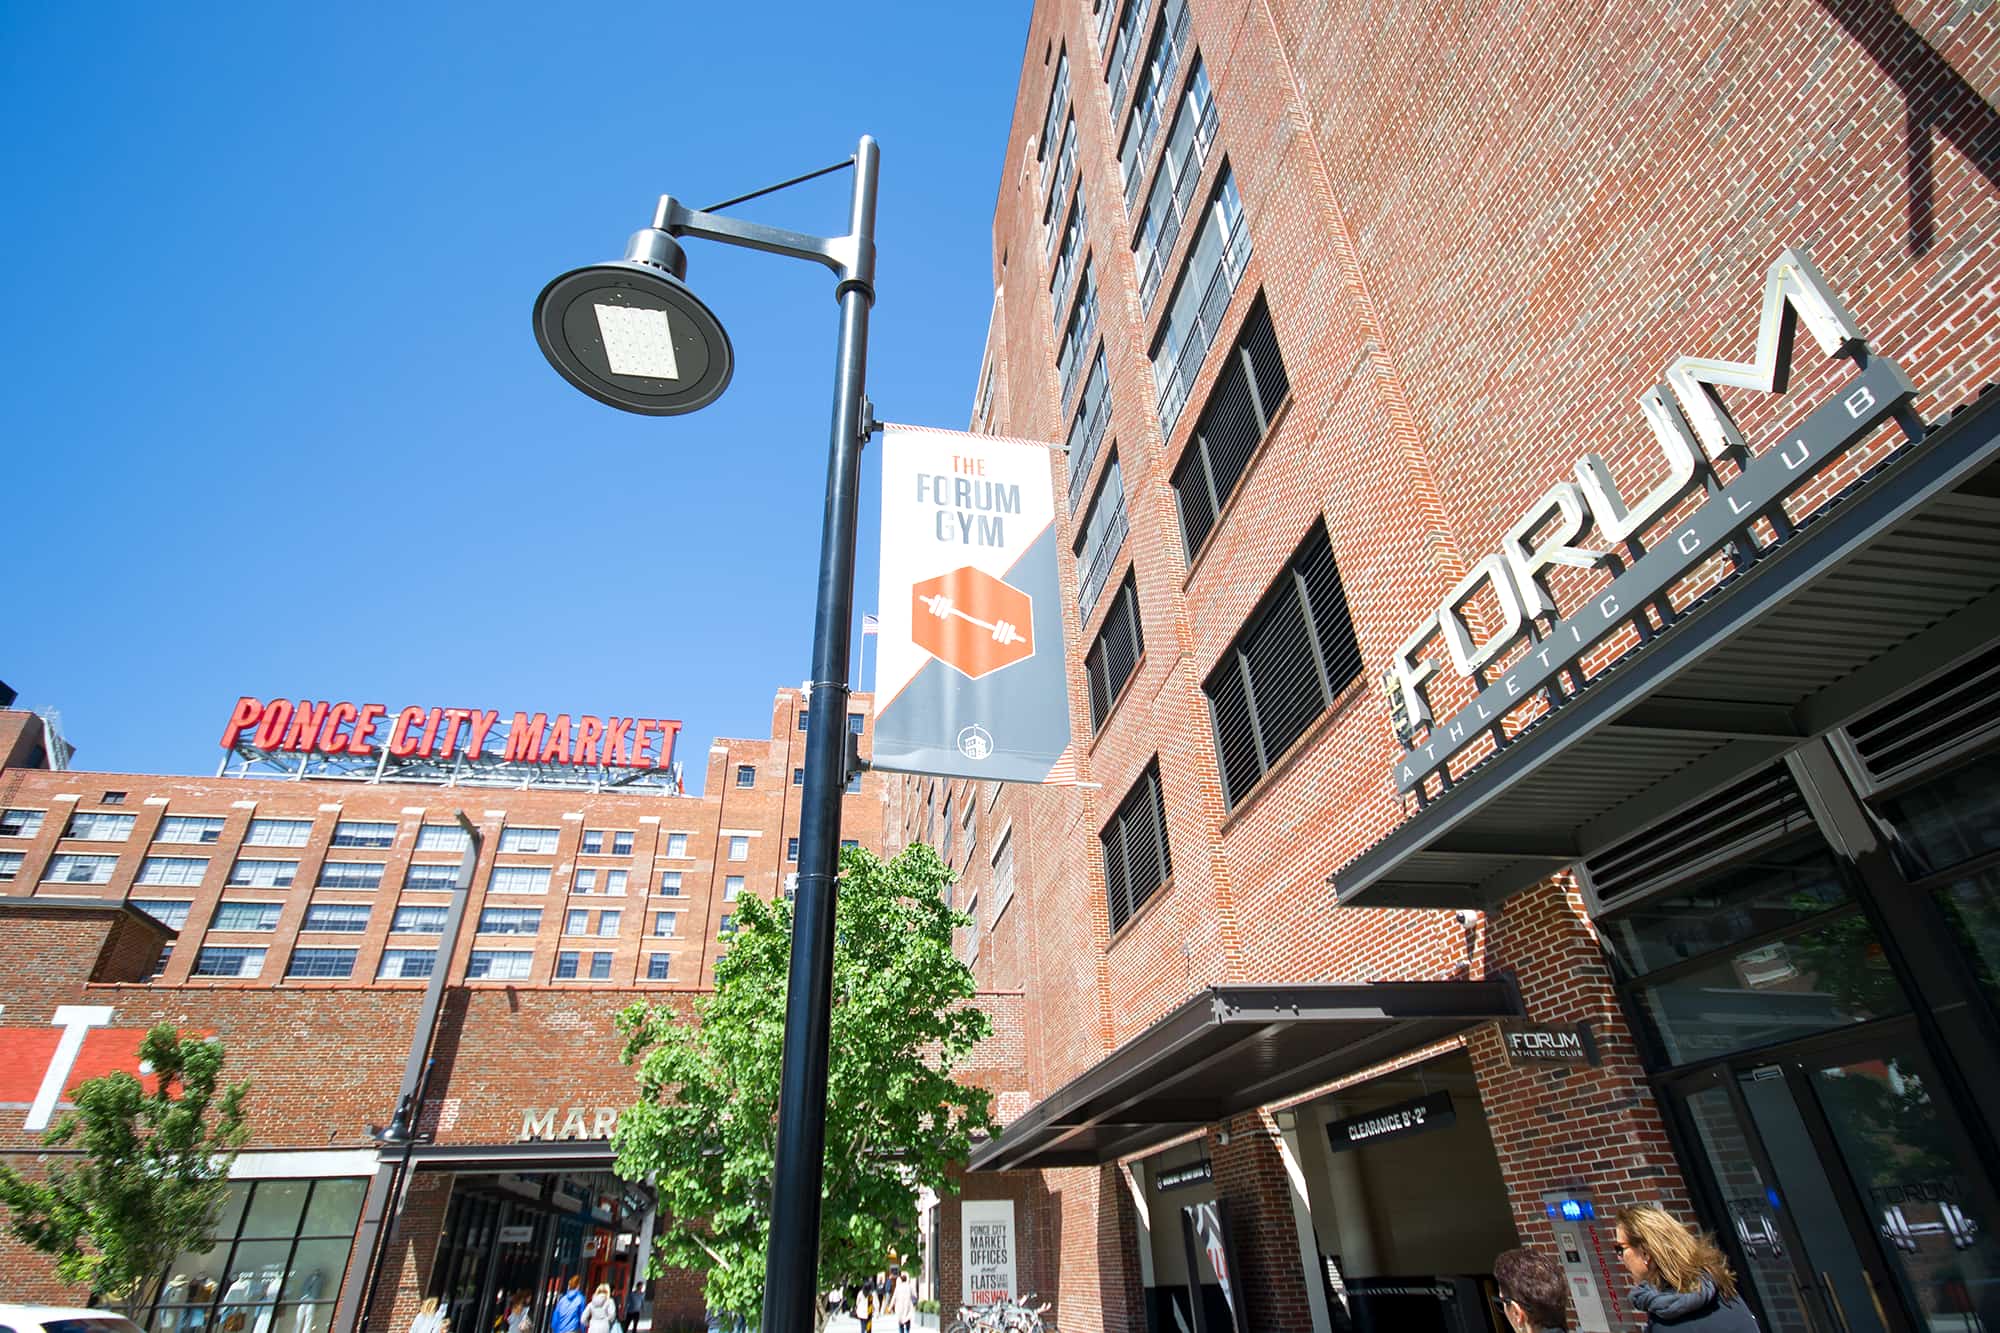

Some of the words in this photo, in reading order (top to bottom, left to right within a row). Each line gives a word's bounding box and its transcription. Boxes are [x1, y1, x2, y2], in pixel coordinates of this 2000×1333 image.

[952, 455, 985, 477] THE
[917, 473, 1021, 515] FORUM
[1395, 247, 1872, 729] FORUM
[936, 510, 1005, 548] GYM
[1402, 593, 1620, 783] ATHLETIC
[1678, 385, 1877, 556] CLUB
[220, 696, 386, 755] PONCE
[390, 705, 499, 760] CITY
[503, 711, 683, 770] MARKET
[1511, 1032, 1580, 1049] FORUM
[517, 1106, 617, 1141] MAR
[1348, 1113, 1402, 1141] CLEARANCE
[970, 1225, 990, 1235] PONCE
[992, 1225, 1006, 1235] CITY
[970, 1235, 1007, 1249] MARKET
[970, 1249, 1008, 1265] OFFICES
[971, 1274, 996, 1290] FLATS
[1588, 1224, 1623, 1323] EMERGENCY
[972, 1291, 990, 1304] THIS
